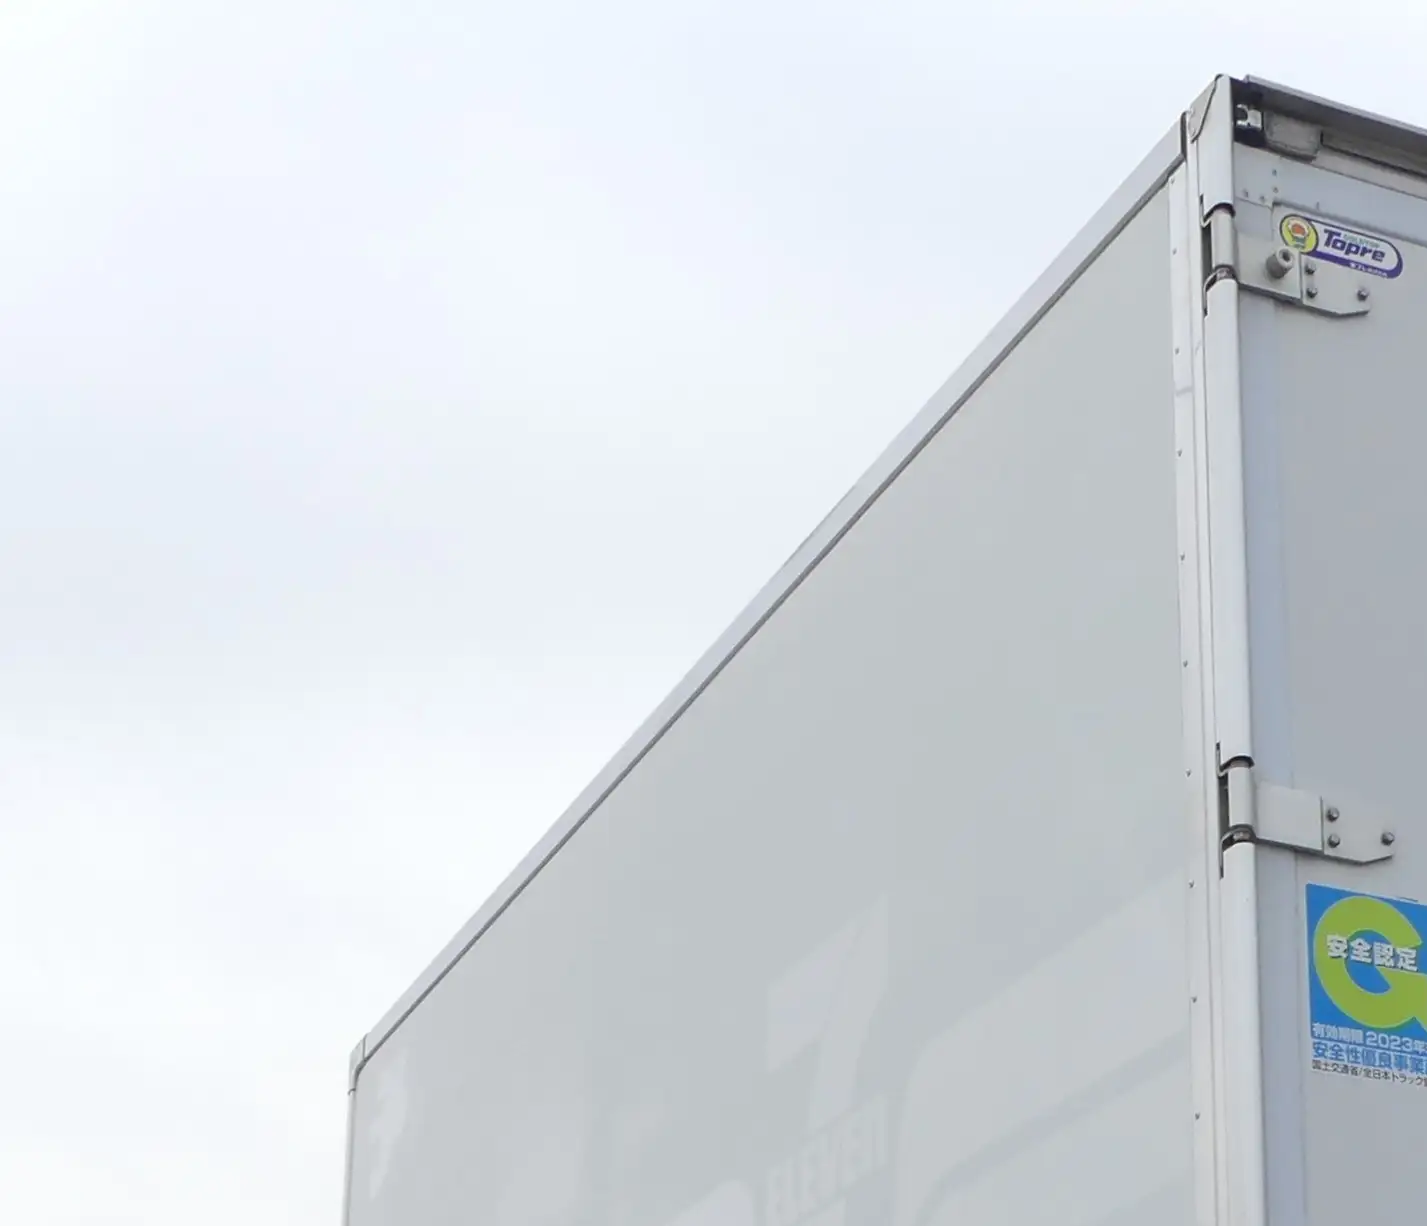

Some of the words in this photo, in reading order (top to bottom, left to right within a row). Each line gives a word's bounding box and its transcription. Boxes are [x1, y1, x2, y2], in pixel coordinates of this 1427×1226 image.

[1323, 229, 1386, 263] Topre
[1326, 933, 1419, 972] 安全認定
